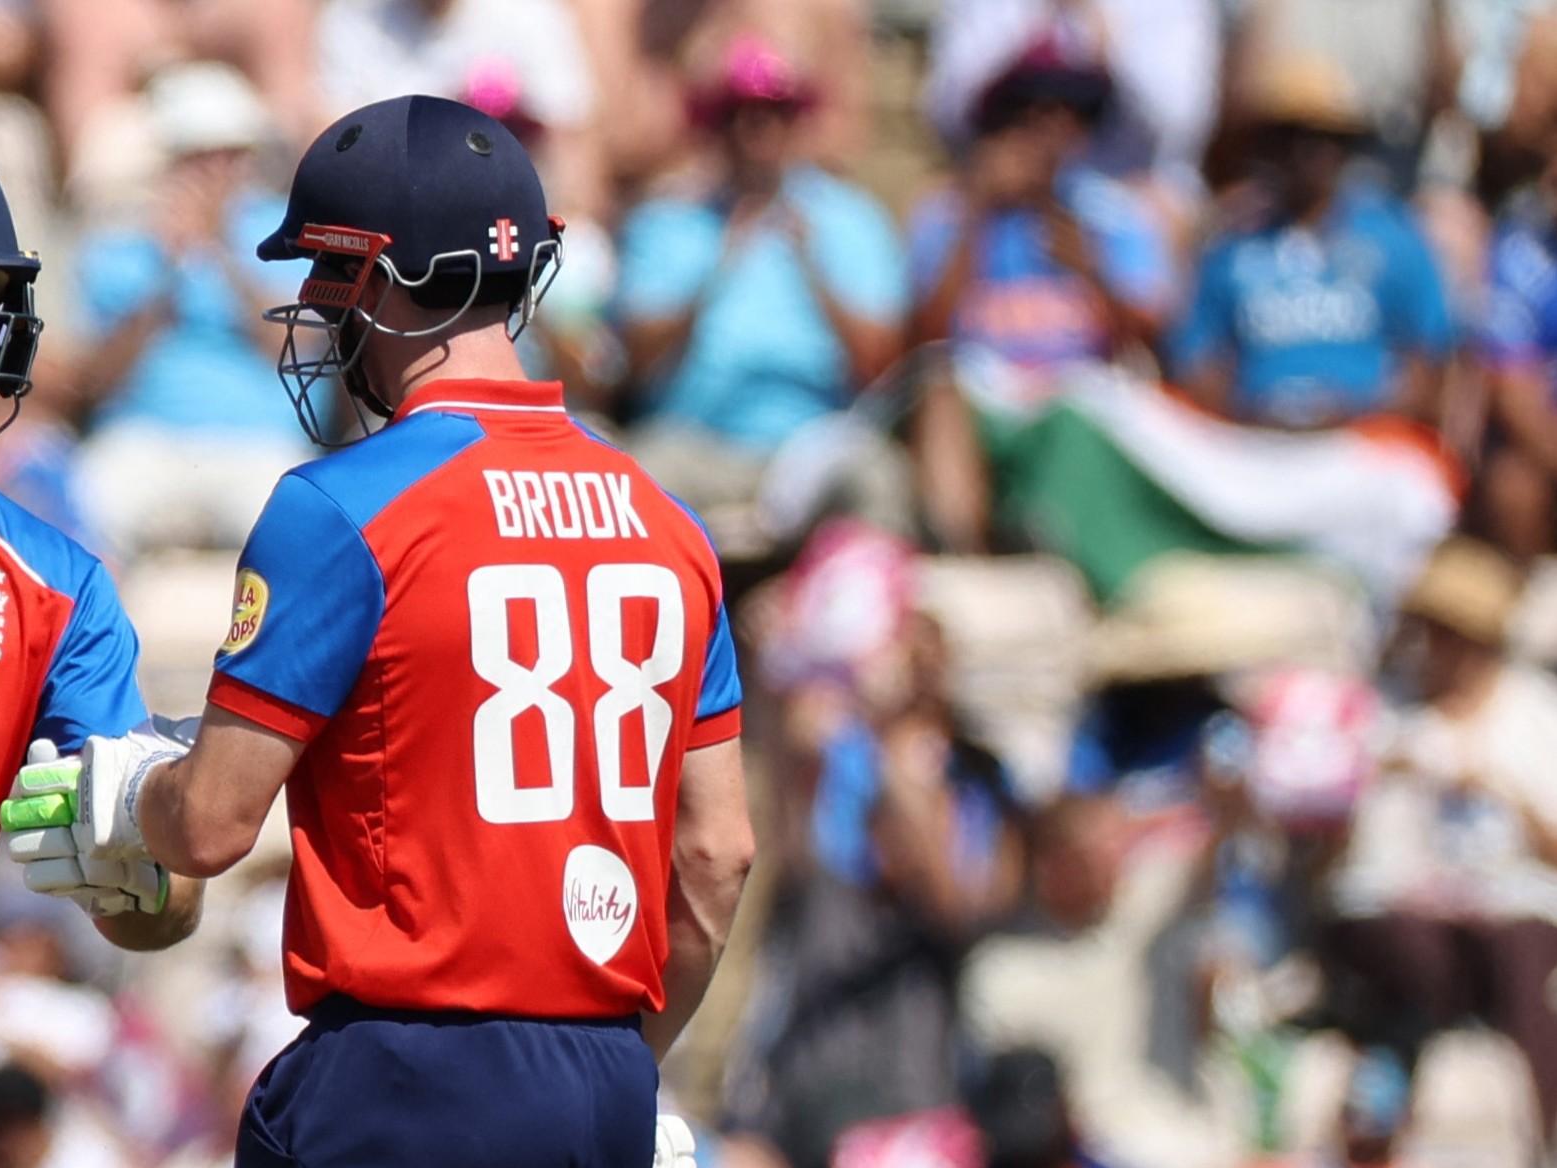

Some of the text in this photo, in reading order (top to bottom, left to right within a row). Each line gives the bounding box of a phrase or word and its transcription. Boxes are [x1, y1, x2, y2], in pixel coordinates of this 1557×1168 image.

[481, 469, 650, 539] BROOK
[229, 614, 257, 642] OPS
[466, 562, 685, 825] 88
[565, 877, 632, 936] Vitality
